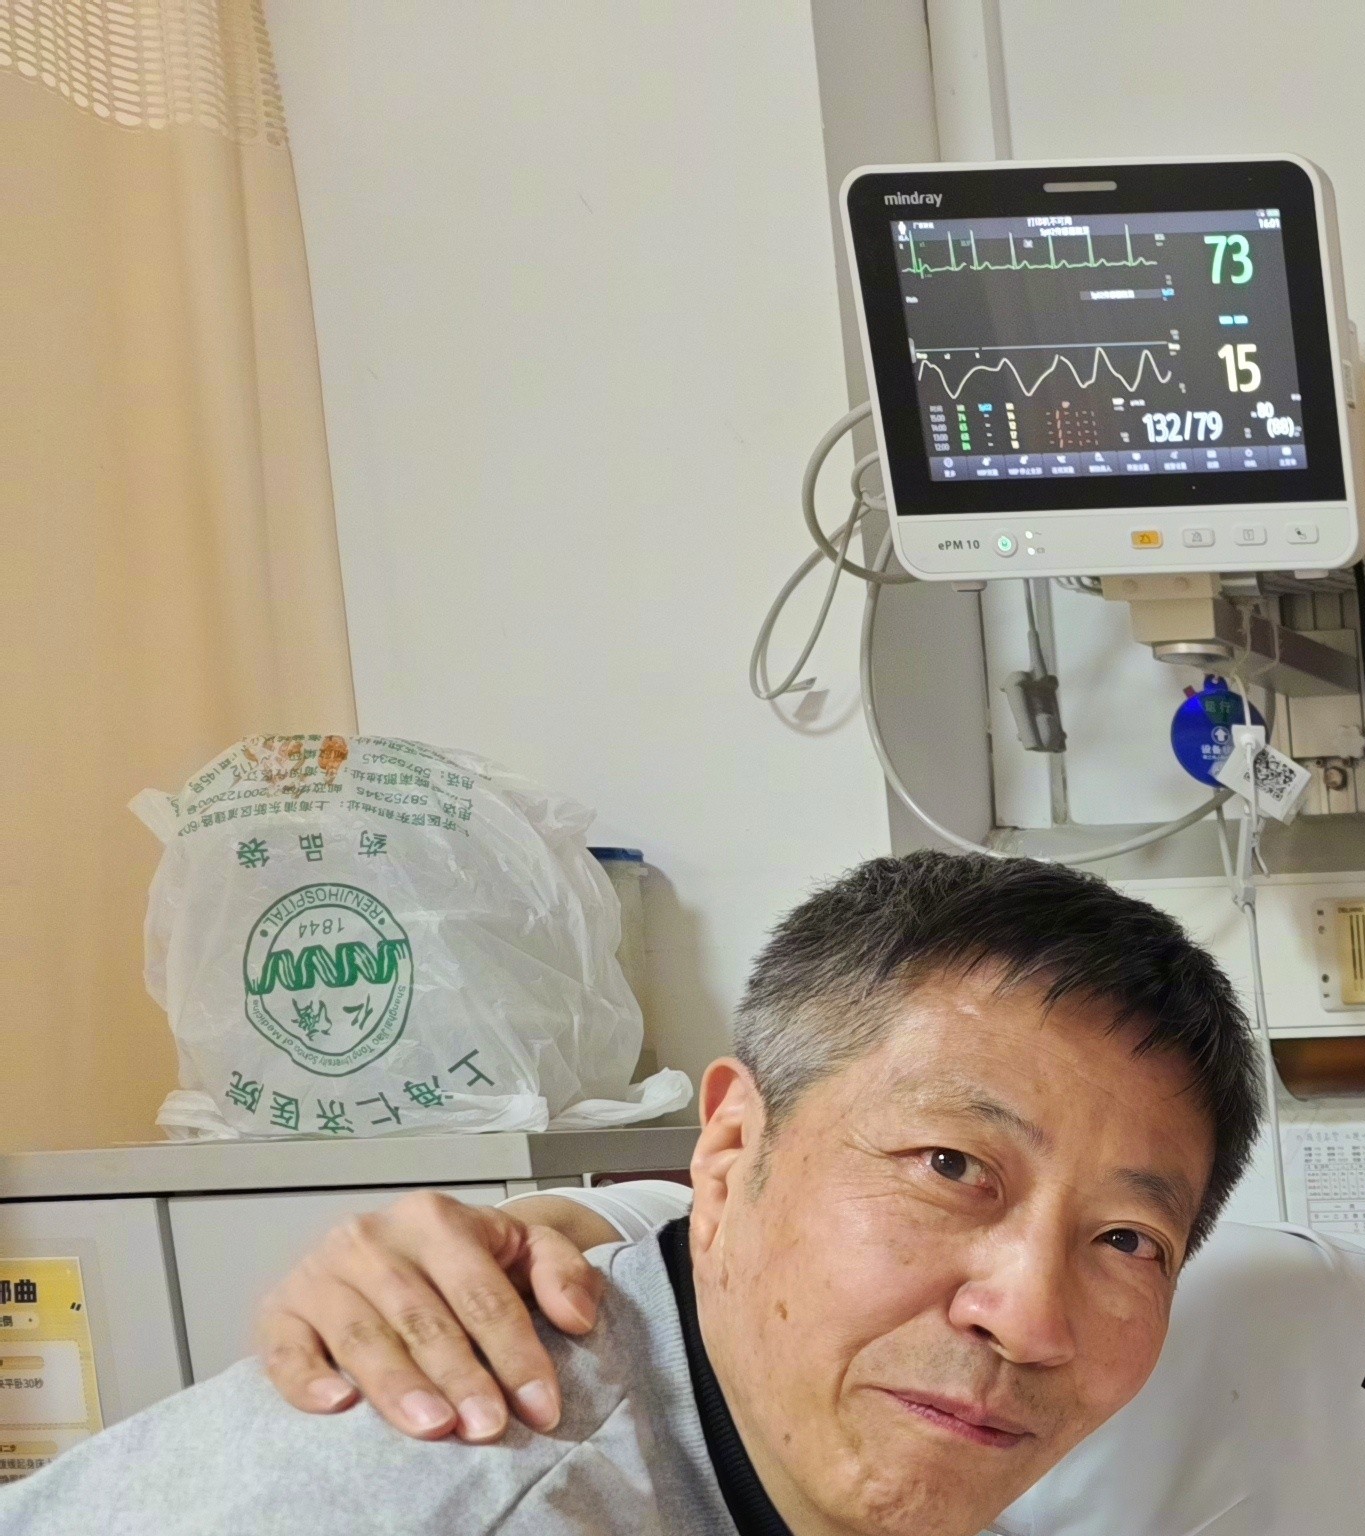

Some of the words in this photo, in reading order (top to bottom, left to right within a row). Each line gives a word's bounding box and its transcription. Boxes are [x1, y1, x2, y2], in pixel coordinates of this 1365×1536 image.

[884, 192, 942, 207] mindray
[1203, 234, 1253, 285] 73
[1217, 343, 1263, 393] 15
[1141, 410, 1224, 443] 132/79
[938, 539, 961, 553] ePM
[963, 538, 981, 551] 10
[298, 917, 346, 939] 1844
[384, 985, 406, 1030] Shanghai
[225, 1049, 495, 1135] 上海仁济医院
